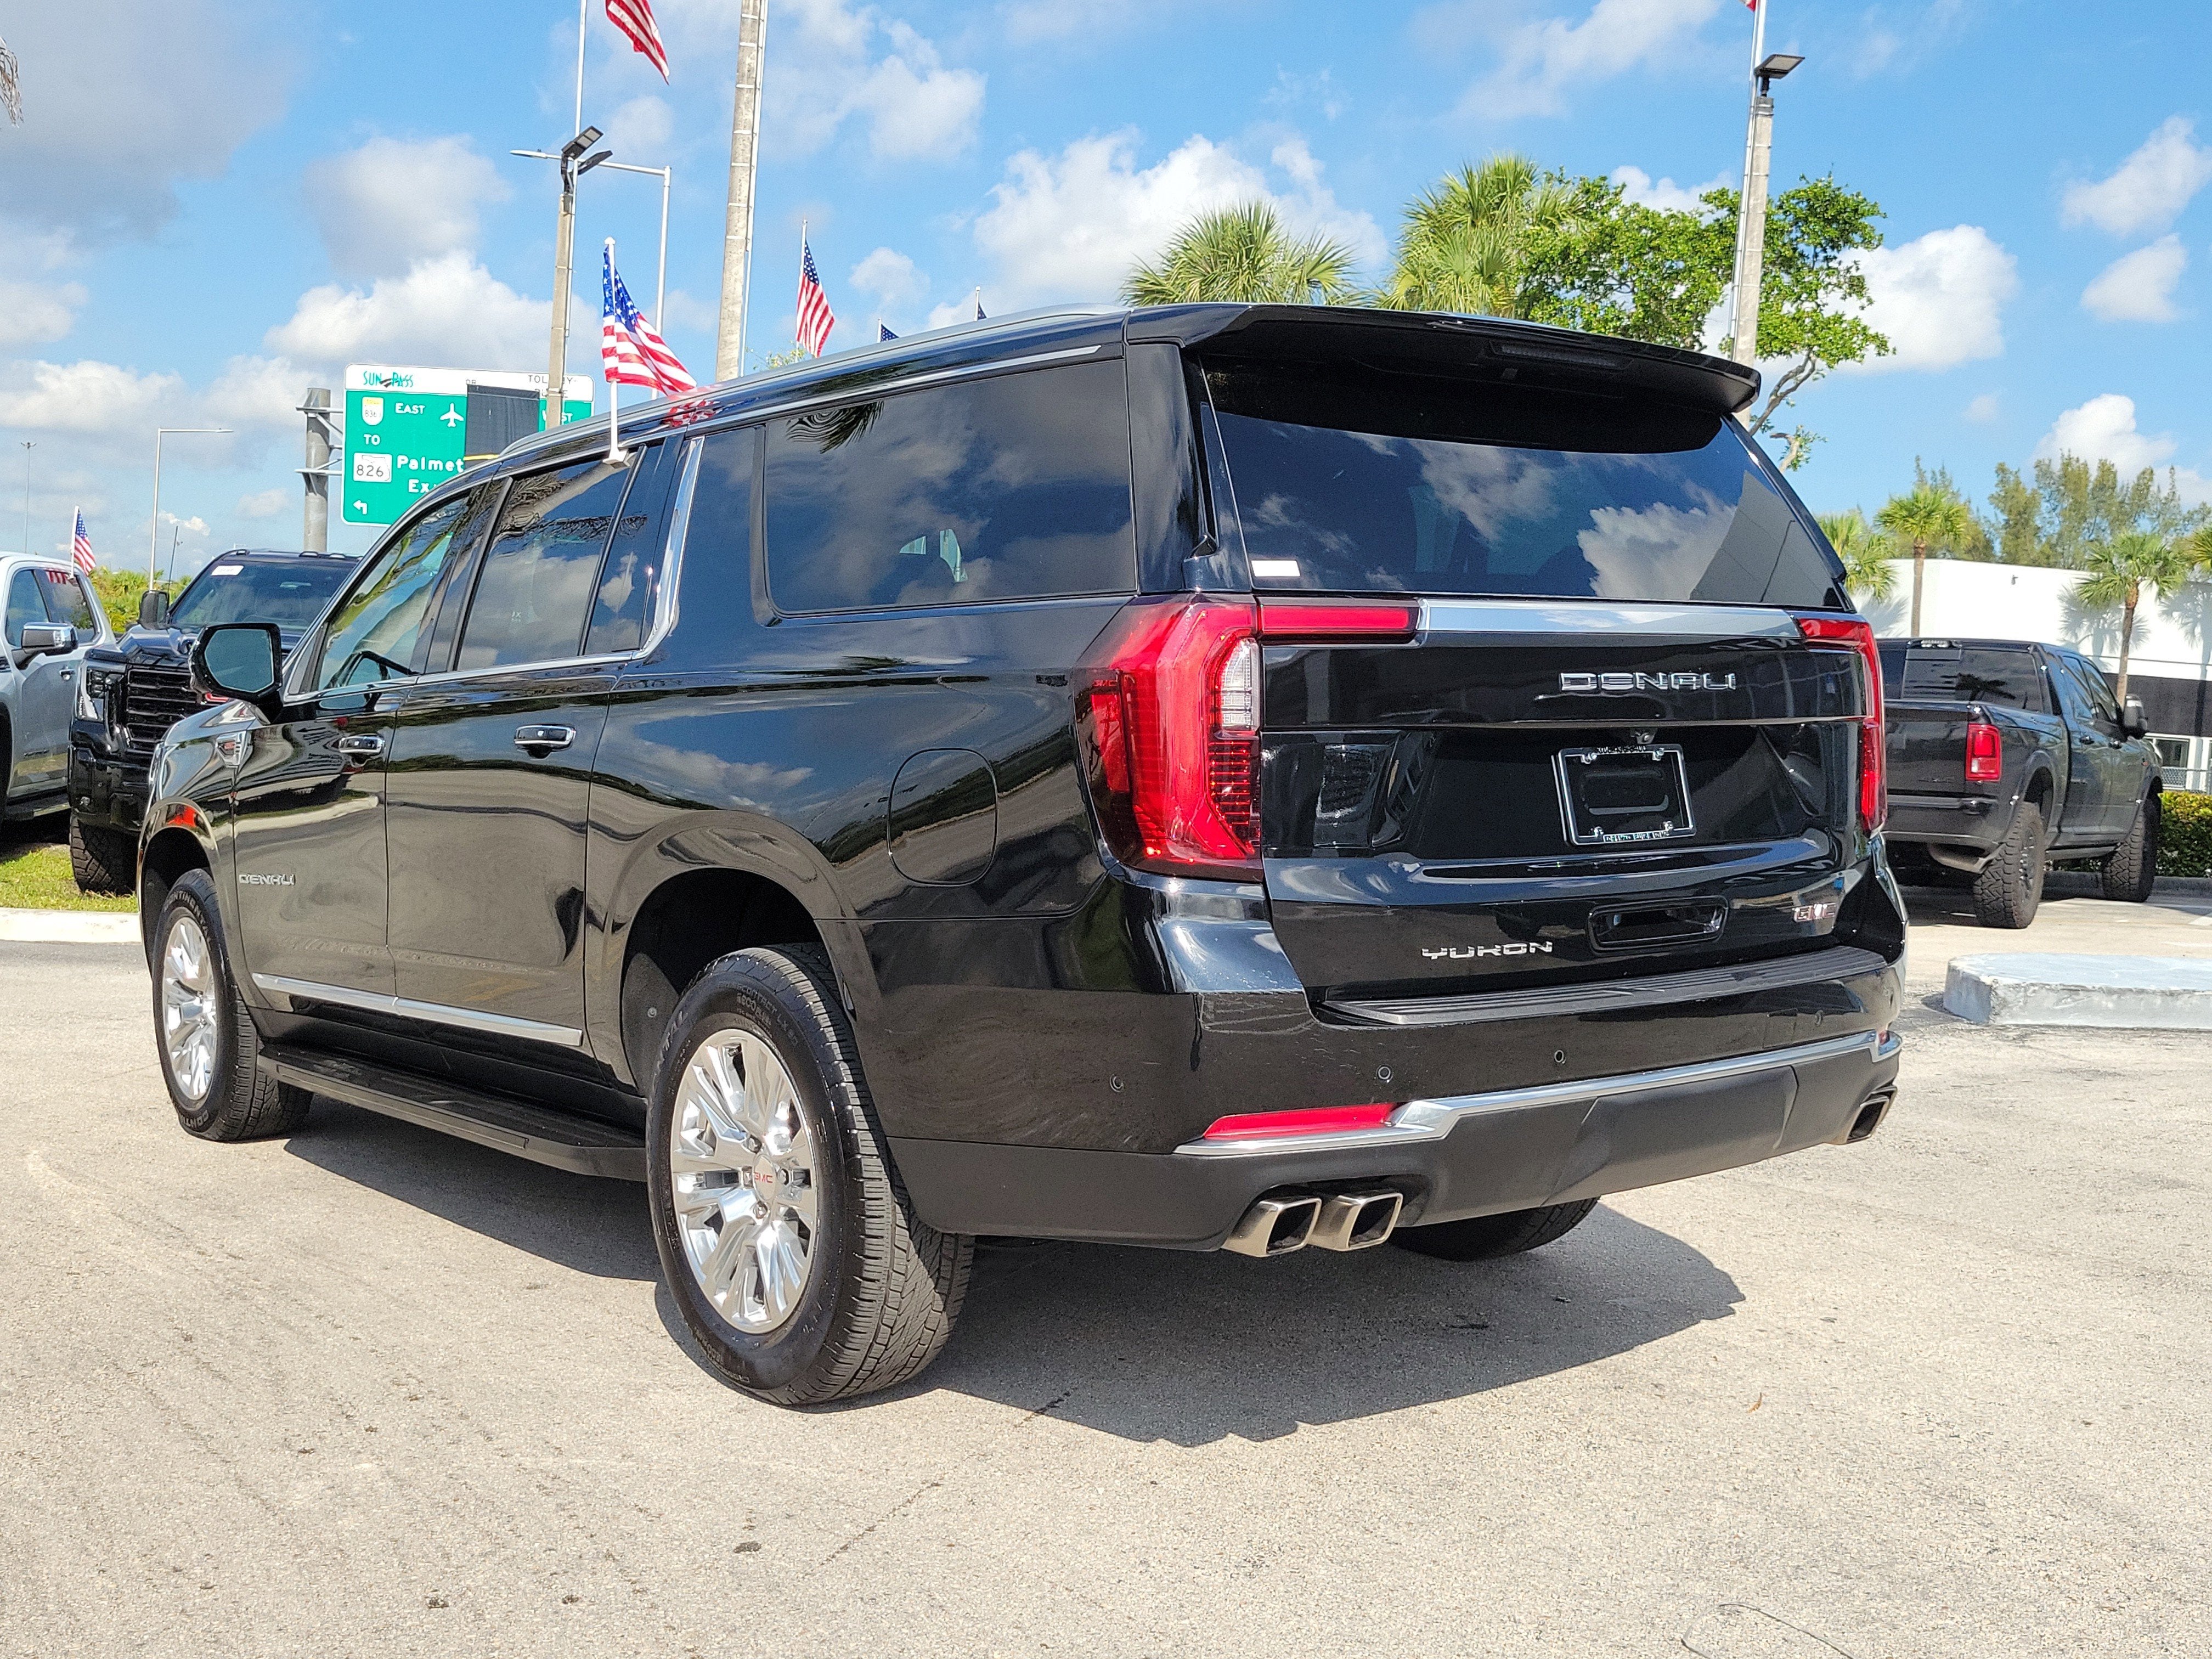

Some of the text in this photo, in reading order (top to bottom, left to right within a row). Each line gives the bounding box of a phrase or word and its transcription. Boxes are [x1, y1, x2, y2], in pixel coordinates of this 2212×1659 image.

[363, 371, 382, 386] SUN
[395, 402, 425, 414] EAST
[363, 433, 380, 445] TO
[357, 465, 383, 477] 826
[408, 479, 439, 493] Ex
[1559, 673, 1736, 691] DENALI
[239, 874, 297, 885] DENALI
[1793, 902, 1837, 922] GMC
[1422, 941, 1553, 960] YUKON
[754, 1172, 773, 1183] GMC
